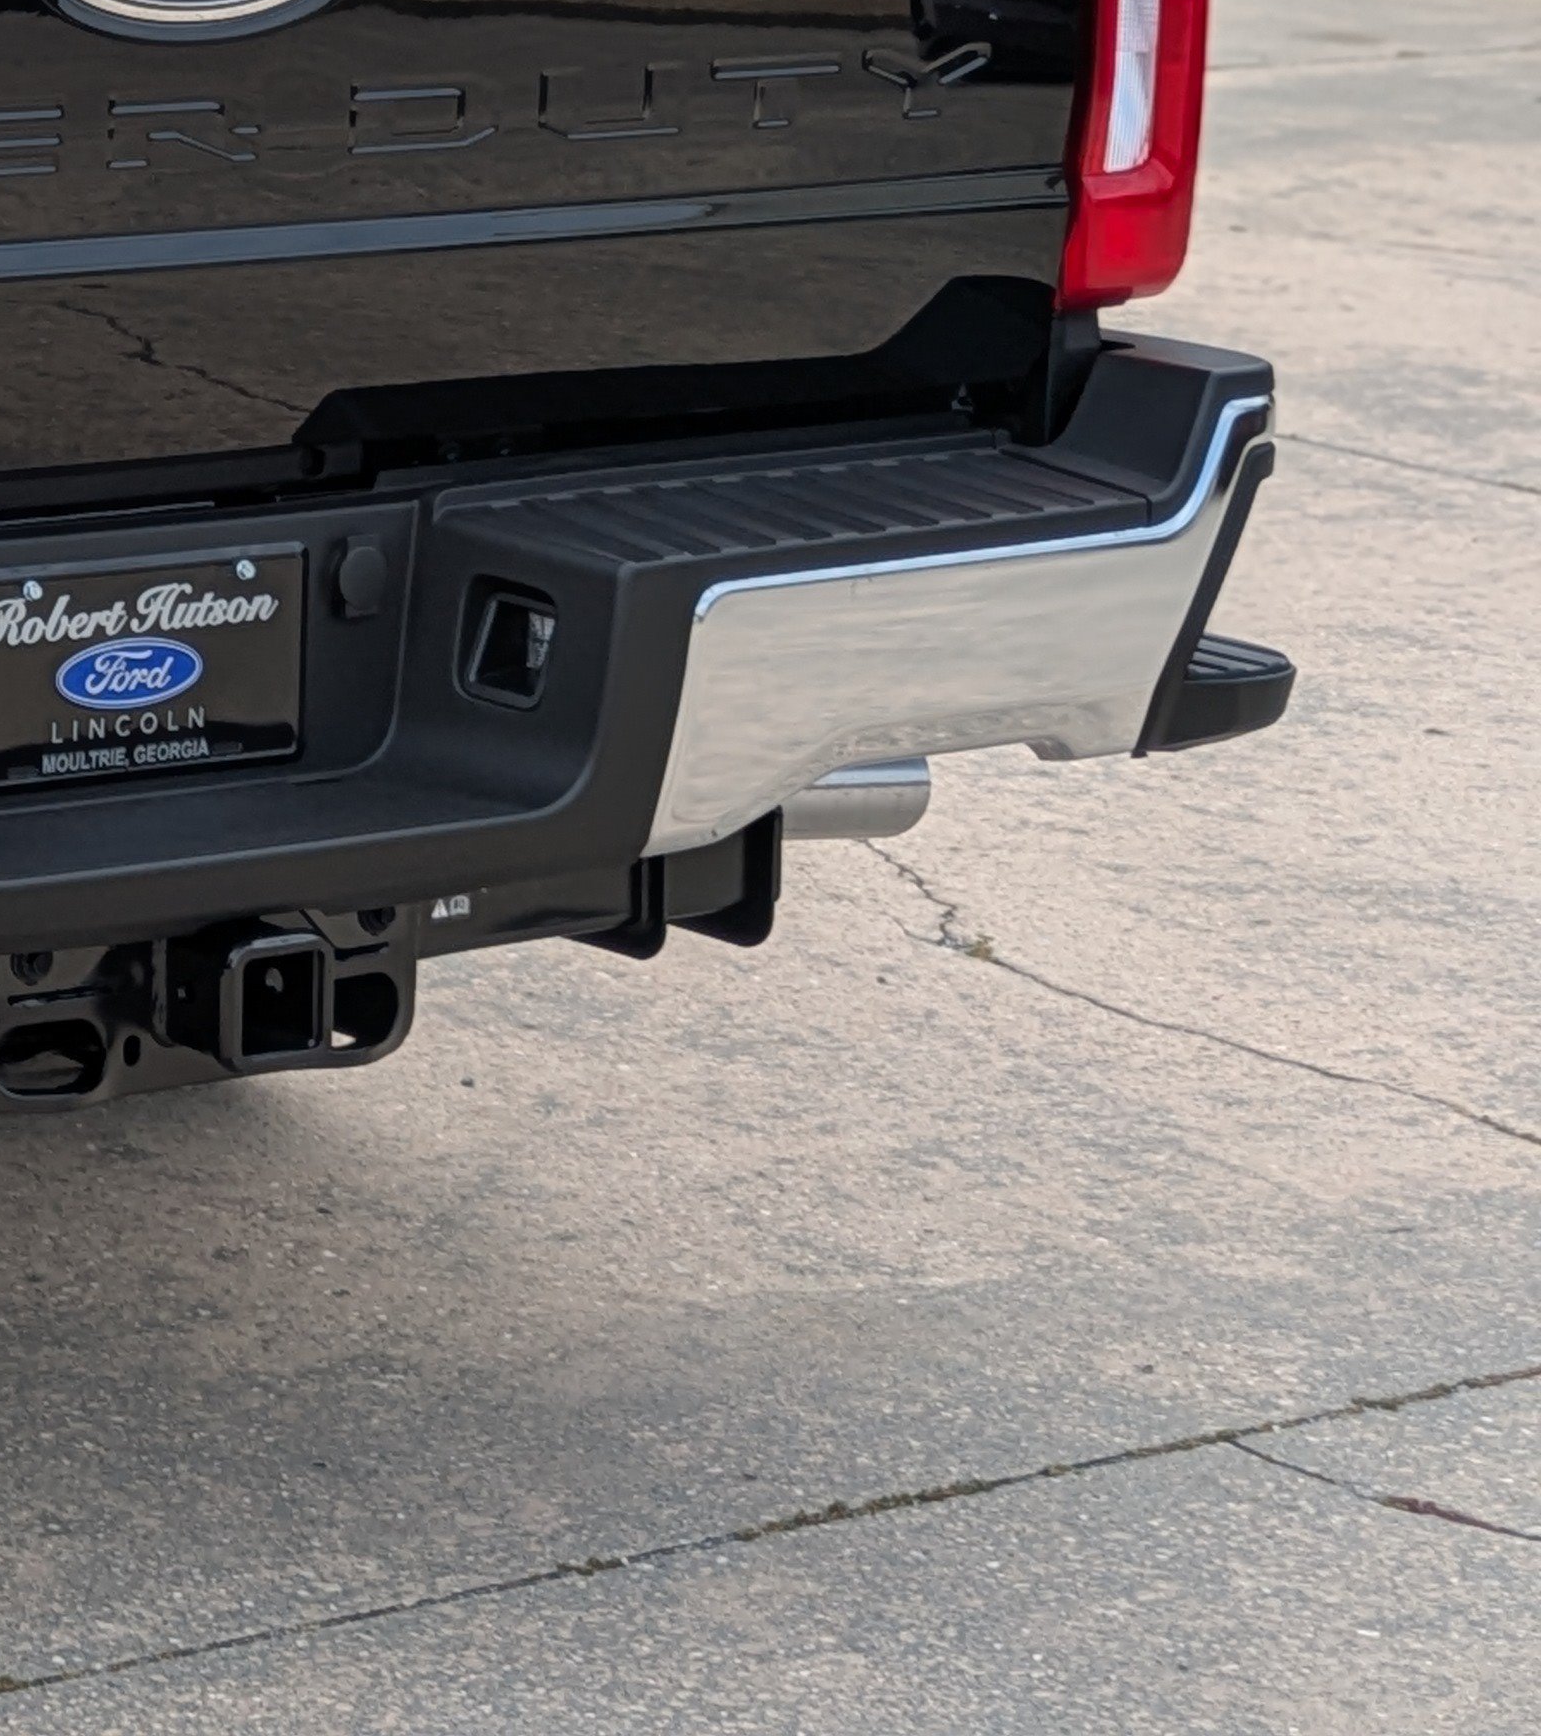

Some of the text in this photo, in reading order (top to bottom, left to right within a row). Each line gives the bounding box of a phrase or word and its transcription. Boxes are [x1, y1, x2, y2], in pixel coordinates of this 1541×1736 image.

[349, 42, 993, 154] DUTY
[130, 583, 278, 634] Hutson
[85, 649, 173, 695] Ford
[52, 706, 206, 744] LINCOLN
[42, 737, 210, 775] MOULTRIE, GEORGIA
